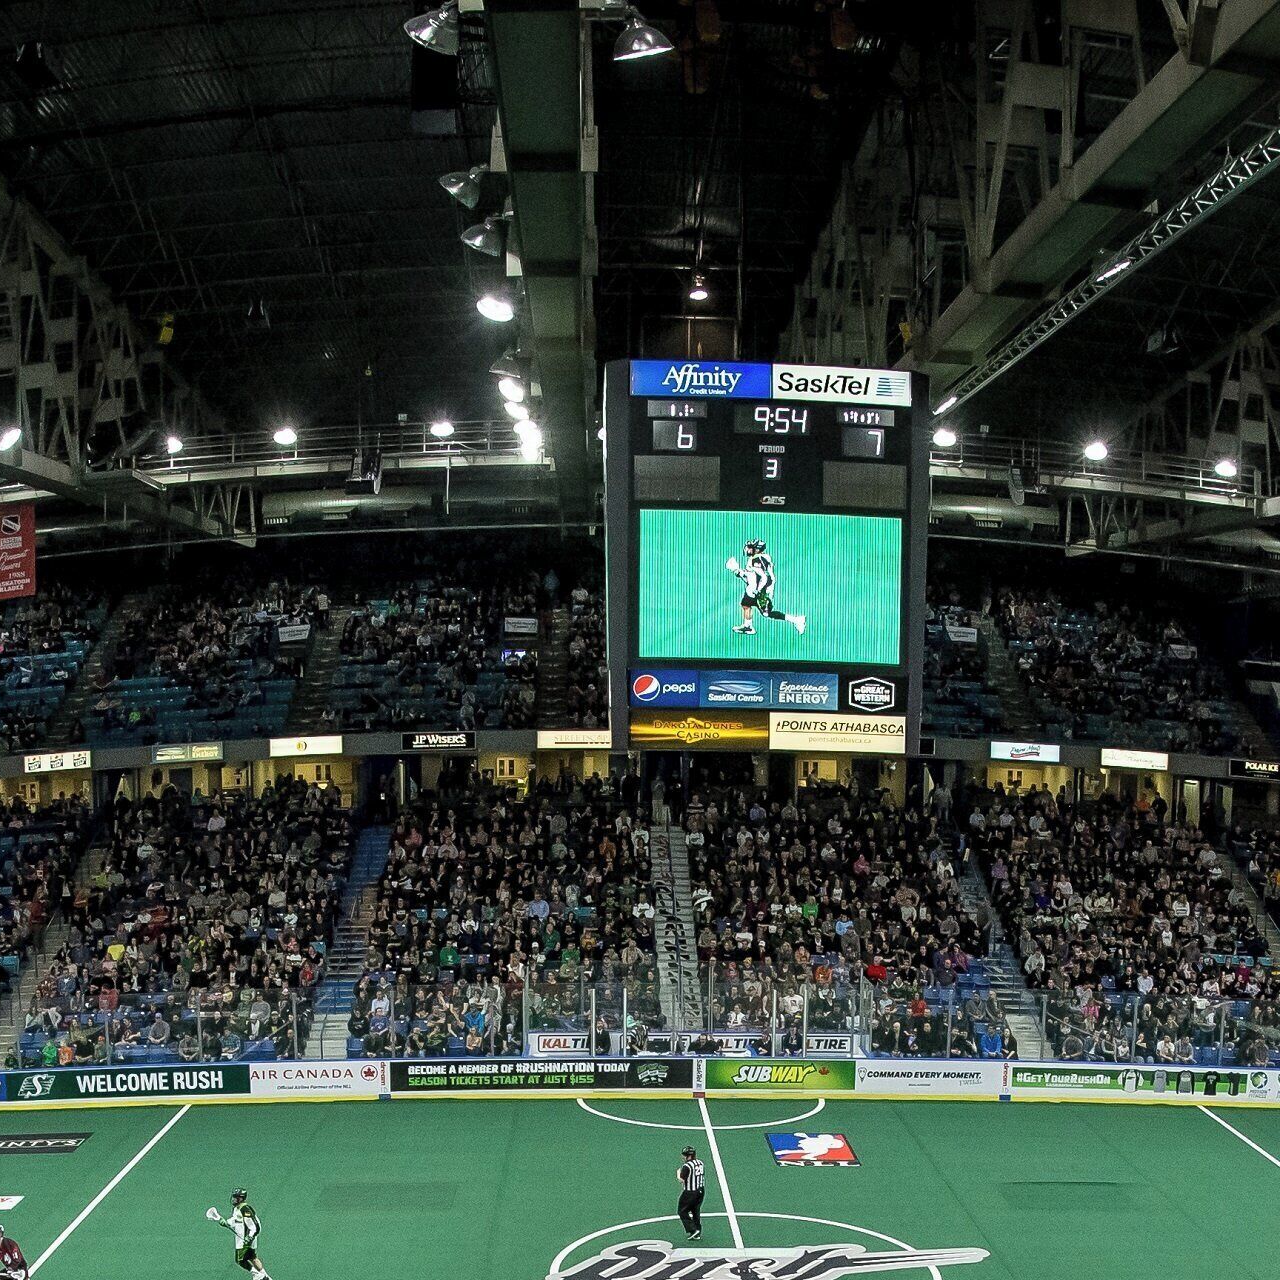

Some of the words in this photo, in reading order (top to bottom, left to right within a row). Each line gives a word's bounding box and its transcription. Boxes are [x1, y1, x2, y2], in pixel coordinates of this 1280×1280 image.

[662, 364, 742, 394] Affinity
[778, 372, 870, 396] SaskTel
[754, 407, 808, 433] 9:54
[677, 424, 693, 449] 6
[759, 445, 785, 453] PERIOD
[868, 431, 882, 456] 7
[766, 459, 778, 478] 3
[0, 585, 24, 593] BLADES
[662, 682, 695, 694] pepsi
[780, 681, 828, 692] Experience
[861, 685, 885, 694] GREAT
[708, 693, 736, 702] SaskTel
[738, 694, 763, 703] Centre
[779, 693, 828, 704] ENERGY
[854, 694, 890, 703] WESTERN
[654, 720, 699, 730] DAKOTA
[703, 720, 743, 730] DUNES
[781, 720, 827, 732] POINTS
[831, 721, 904, 734] ATHABASCA
[677, 730, 720, 740] CASINO
[1245, 762, 1267, 771] POLAR
[1268, 764, 1279, 772] ICE
[815, 1038, 848, 1049] TIRE
[250, 1069, 278, 1080] AIR
[283, 1068, 354, 1080] CANADA
[408, 1065, 447, 1075] BECOME
[449, 1066, 457, 1074] A
[458, 1064, 499, 1074] MEMBER
[500, 1064, 514, 1073] OF
[516, 1062, 595, 1073] #RUSHNATION
[597, 1063, 630, 1073] TODAY
[735, 1065, 814, 1083] SUBWAY
[1002, 1062, 1010, 1087] dream
[408, 1077, 447, 1087] SEASON
[450, 1076, 491, 1086] TICKETS
[493, 1076, 525, 1085] START
[528, 1075, 540, 1084] AT
[543, 1075, 567, 1084] JUST
[570, 1074, 595, 1086] $155
[867, 1071, 913, 1079] COMMAND
[914, 1071, 941, 1079] EVERY
[942, 1071, 982, 1080] MOMENT.
[77, 1073, 169, 1093] WELCOME
[173, 1071, 223, 1090] RUSH
